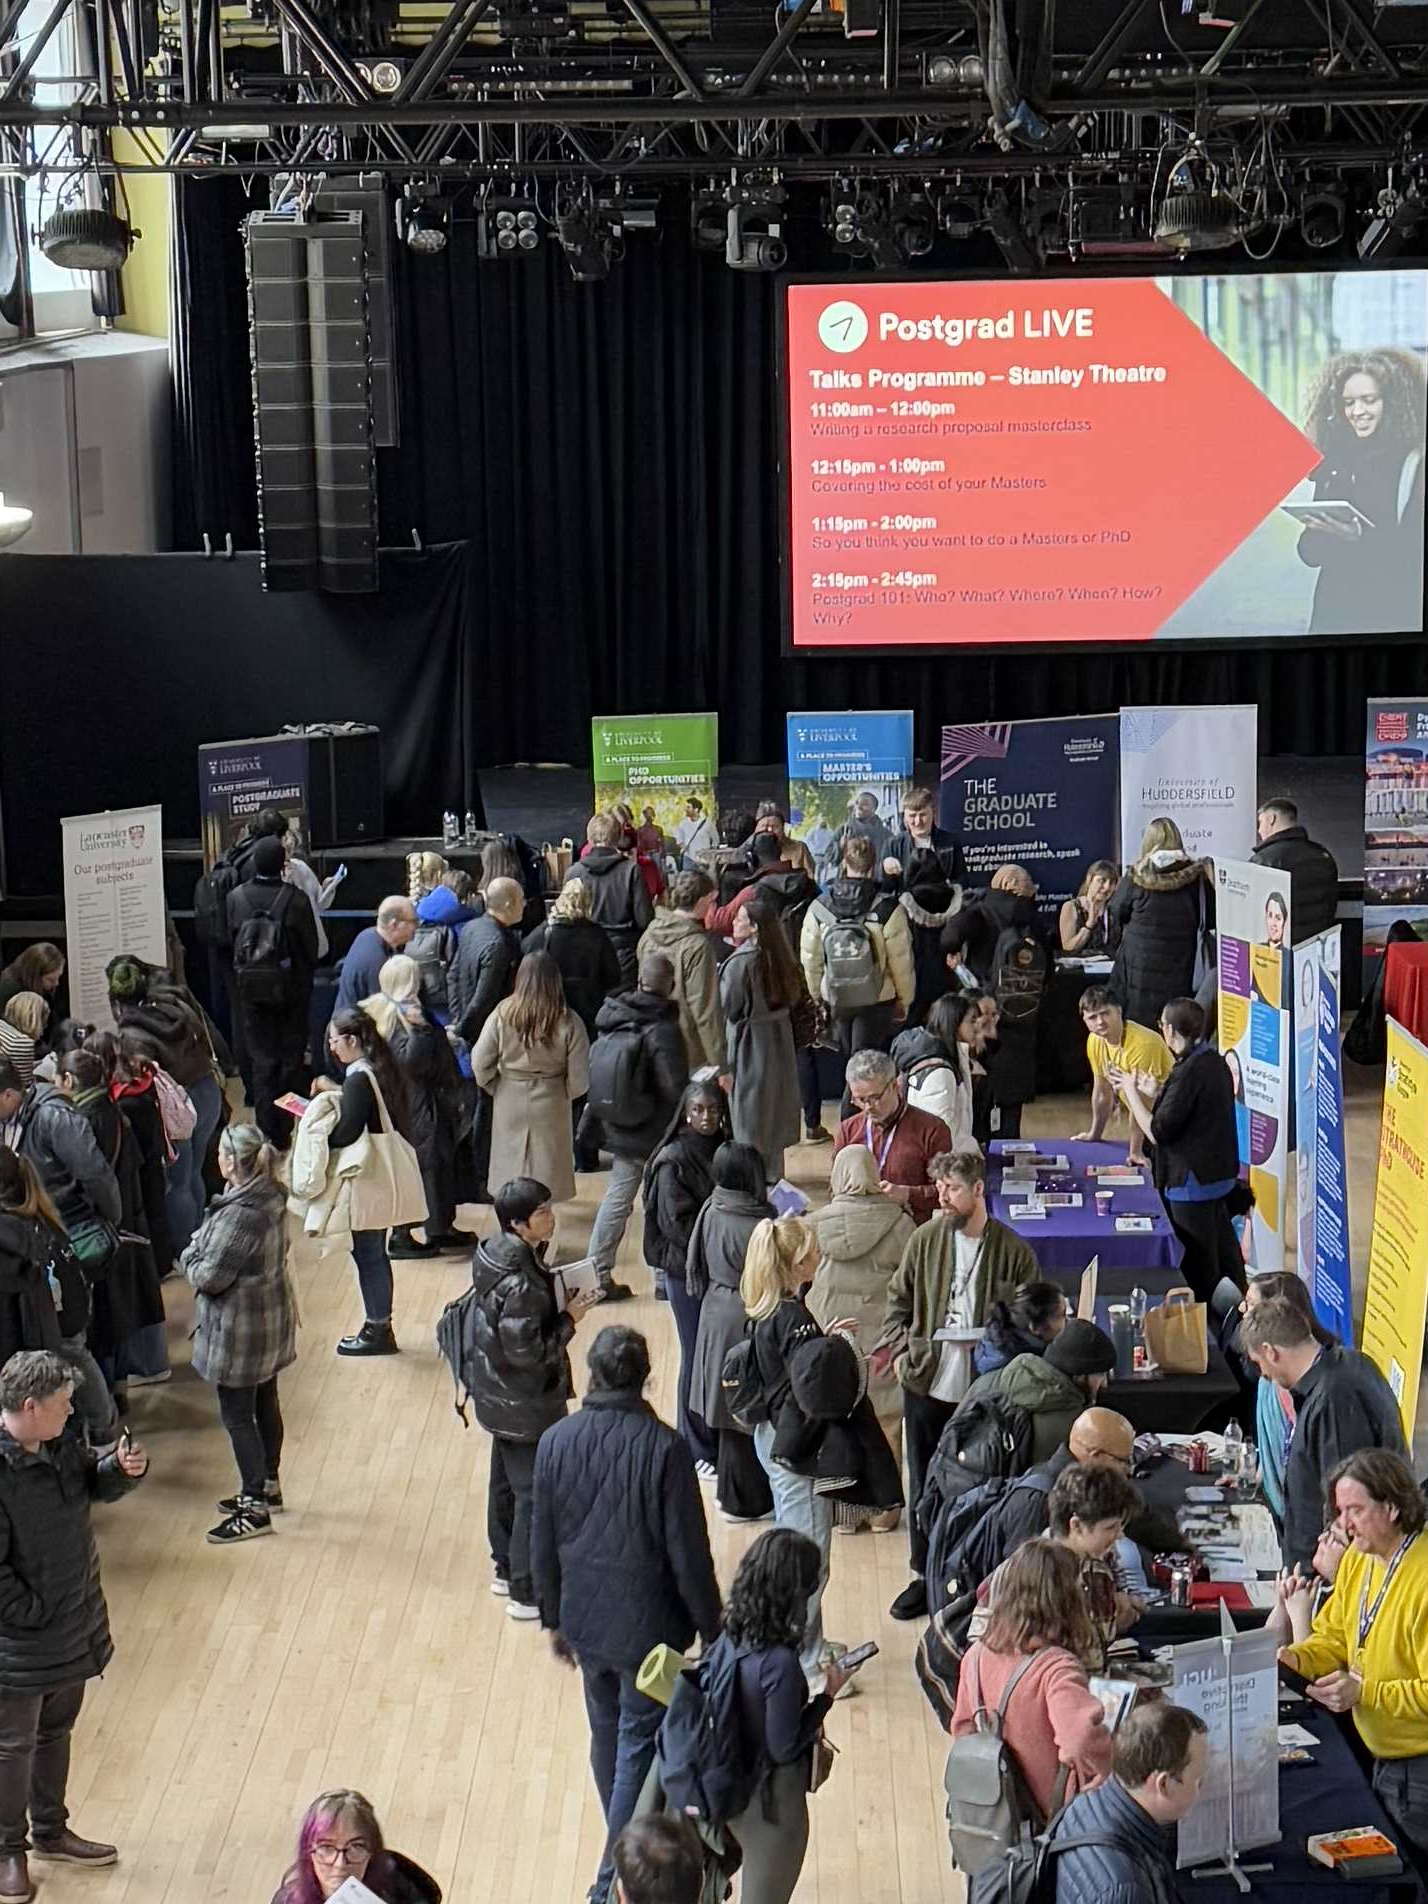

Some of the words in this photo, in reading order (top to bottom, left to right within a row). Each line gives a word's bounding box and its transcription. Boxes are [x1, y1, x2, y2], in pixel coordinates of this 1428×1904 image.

[879, 310, 1015, 347] Postgrad
[1024, 308, 1094, 338] LIVE
[809, 369, 863, 390] Talks
[868, 370, 986, 392] Programme
[1008, 365, 1084, 388] Stanley
[1089, 364, 1167, 384] Theatre
[811, 402, 874, 417] 11:00am
[890, 400, 956, 418] 12:00pm
[811, 422, 859, 438] Writing
[877, 421, 938, 435] research
[942, 419, 1004, 437] proposal
[1007, 418, 1092, 433] masterclass
[890, 457, 945, 475] 1:00pm
[812, 479, 875, 495] Covering
[878, 479, 900, 492] the
[905, 478, 934, 491] cost
[938, 477, 952, 491] of
[956, 478, 987, 493] your
[990, 476, 1047, 489] Masters
[880, 515, 937, 532] 2:00pm
[812, 536, 831, 549] So
[835, 537, 860, 551] you
[865, 535, 898, 549] think
[902, 537, 929, 551] you
[932, 533, 966, 547] want
[969, 534, 984, 546] to
[987, 532, 1005, 546] do
[1022, 531, 1078, 545] Masters
[1082, 533, 1097, 544] or
[1100, 530, 1132, 543] PhD
[881, 572, 937, 588] 2:45pm
[812, 592, 875, 608] Postgrad
[880, 591, 909, 605] 101:
[915, 590, 956, 603] Who?
[960, 589, 1004, 603] What?
[1009, 587, 1064, 602] Where?
[1122, 586, 1162, 599] How?
[813, 611, 852, 625] Why?
[964, 778, 997, 796] THE
[1142, 786, 1235, 800] HUDDERSFIELD
[964, 792, 1057, 814] GRADUATE
[963, 812, 1035, 832] SCHOOL
[74, 863, 91, 876] Our
[94, 856, 153, 876] postgraduate
[96, 873, 134, 886] subjects
